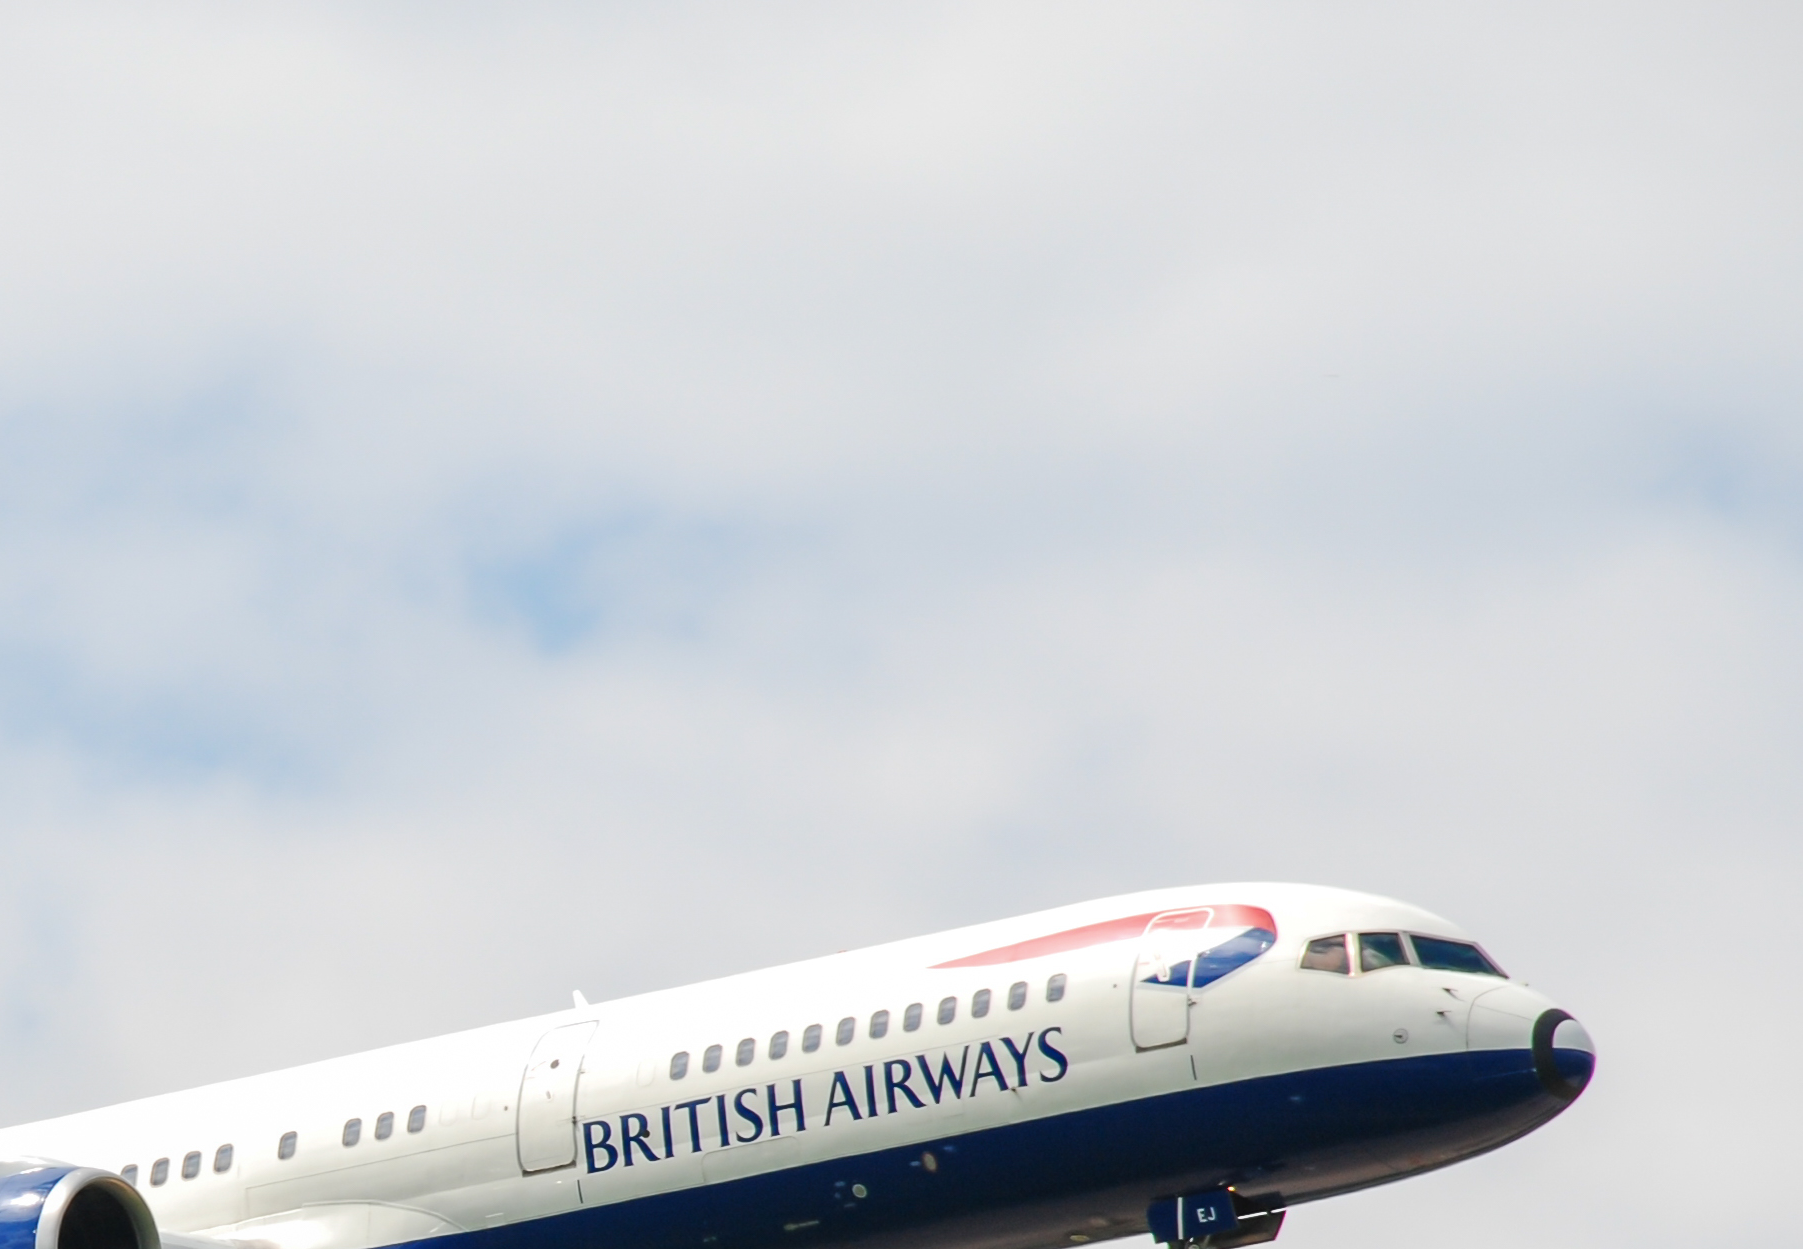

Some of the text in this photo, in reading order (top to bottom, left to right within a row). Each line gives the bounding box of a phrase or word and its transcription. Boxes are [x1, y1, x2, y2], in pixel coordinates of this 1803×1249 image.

[581, 1026, 1070, 1175] BRITISH AIRWAYS
[1196, 1206, 1217, 1223] EJ
